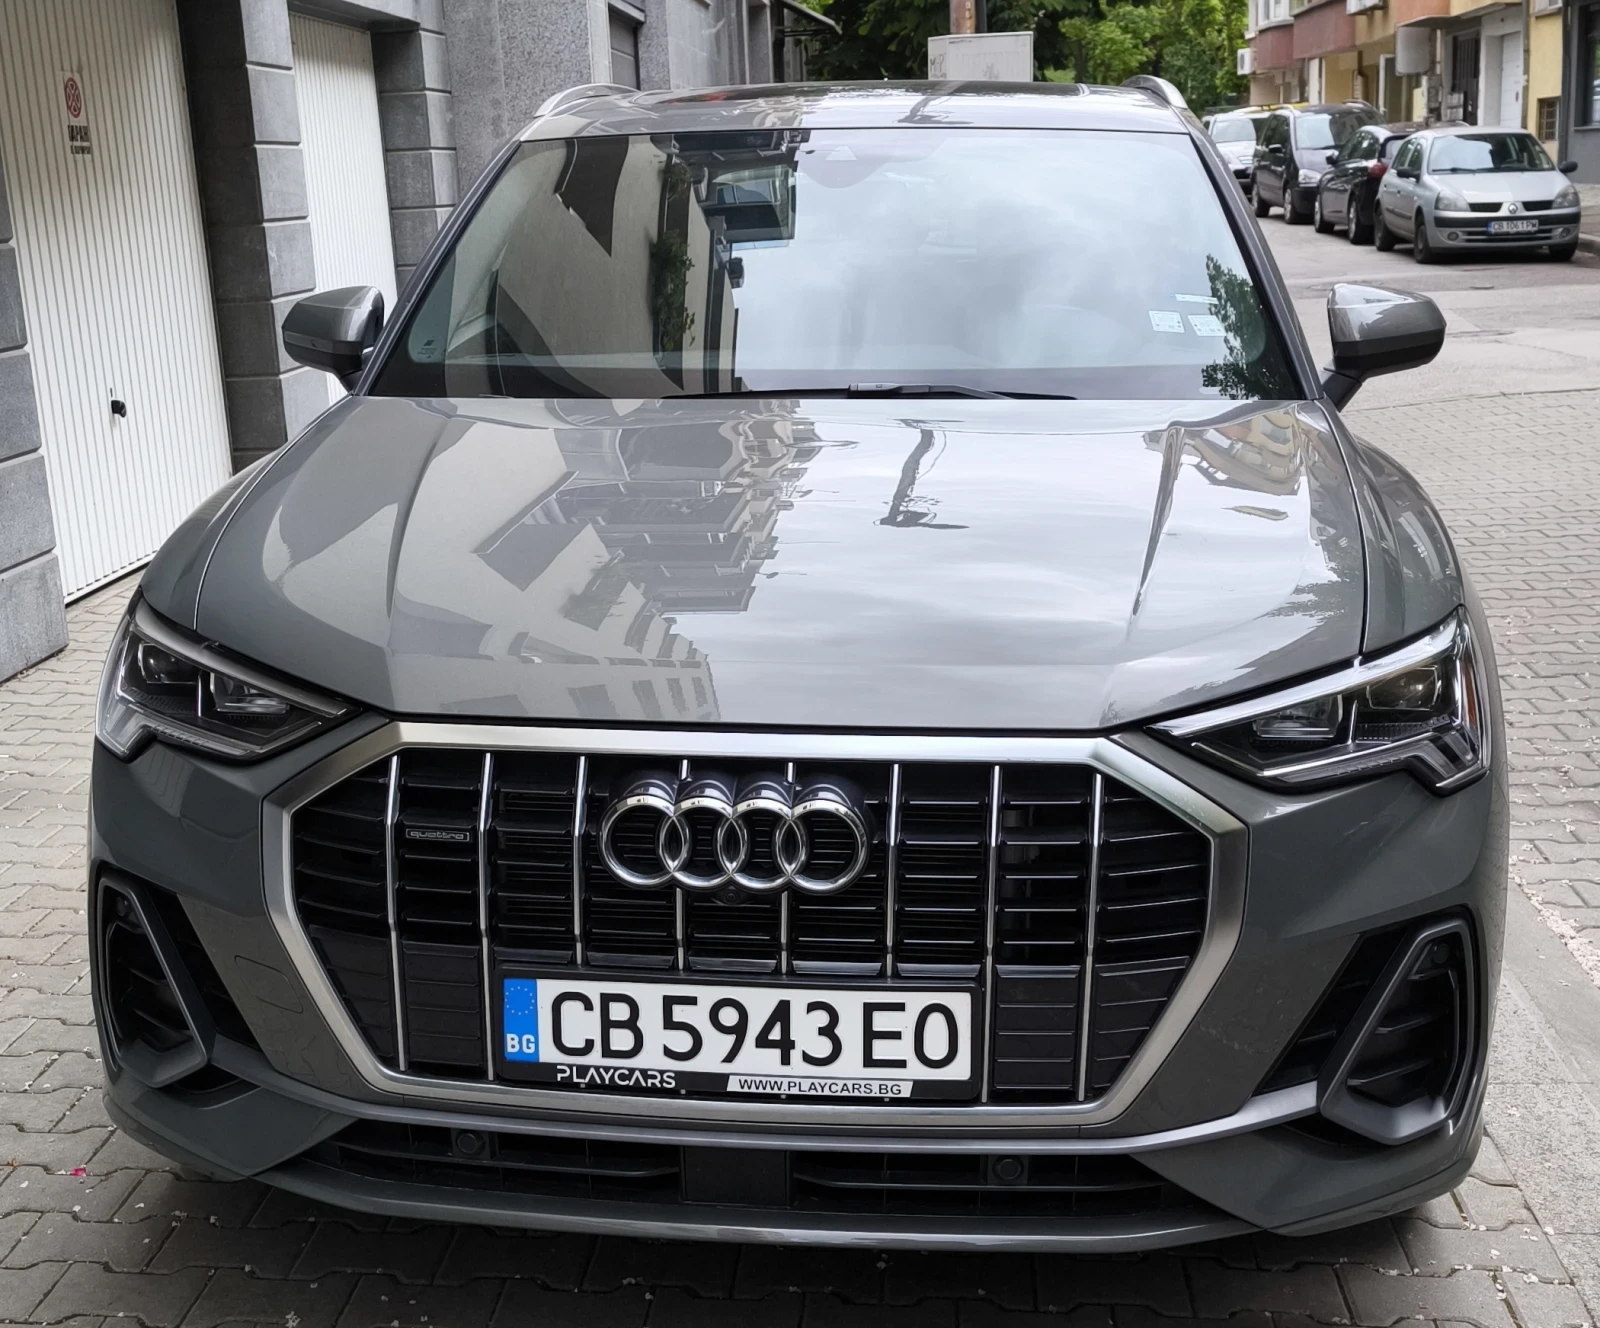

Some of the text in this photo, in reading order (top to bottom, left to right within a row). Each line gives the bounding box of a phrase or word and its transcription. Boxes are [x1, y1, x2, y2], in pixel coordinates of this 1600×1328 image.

[410, 831, 464, 840] quattro
[552, 991, 644, 1059] CB
[662, 994, 843, 1067] 5943
[506, 1033, 536, 1054] BG
[556, 1065, 676, 1088] PLAYCARS
[738, 1078, 903, 1096] WWW.PLAYCARS.BG
